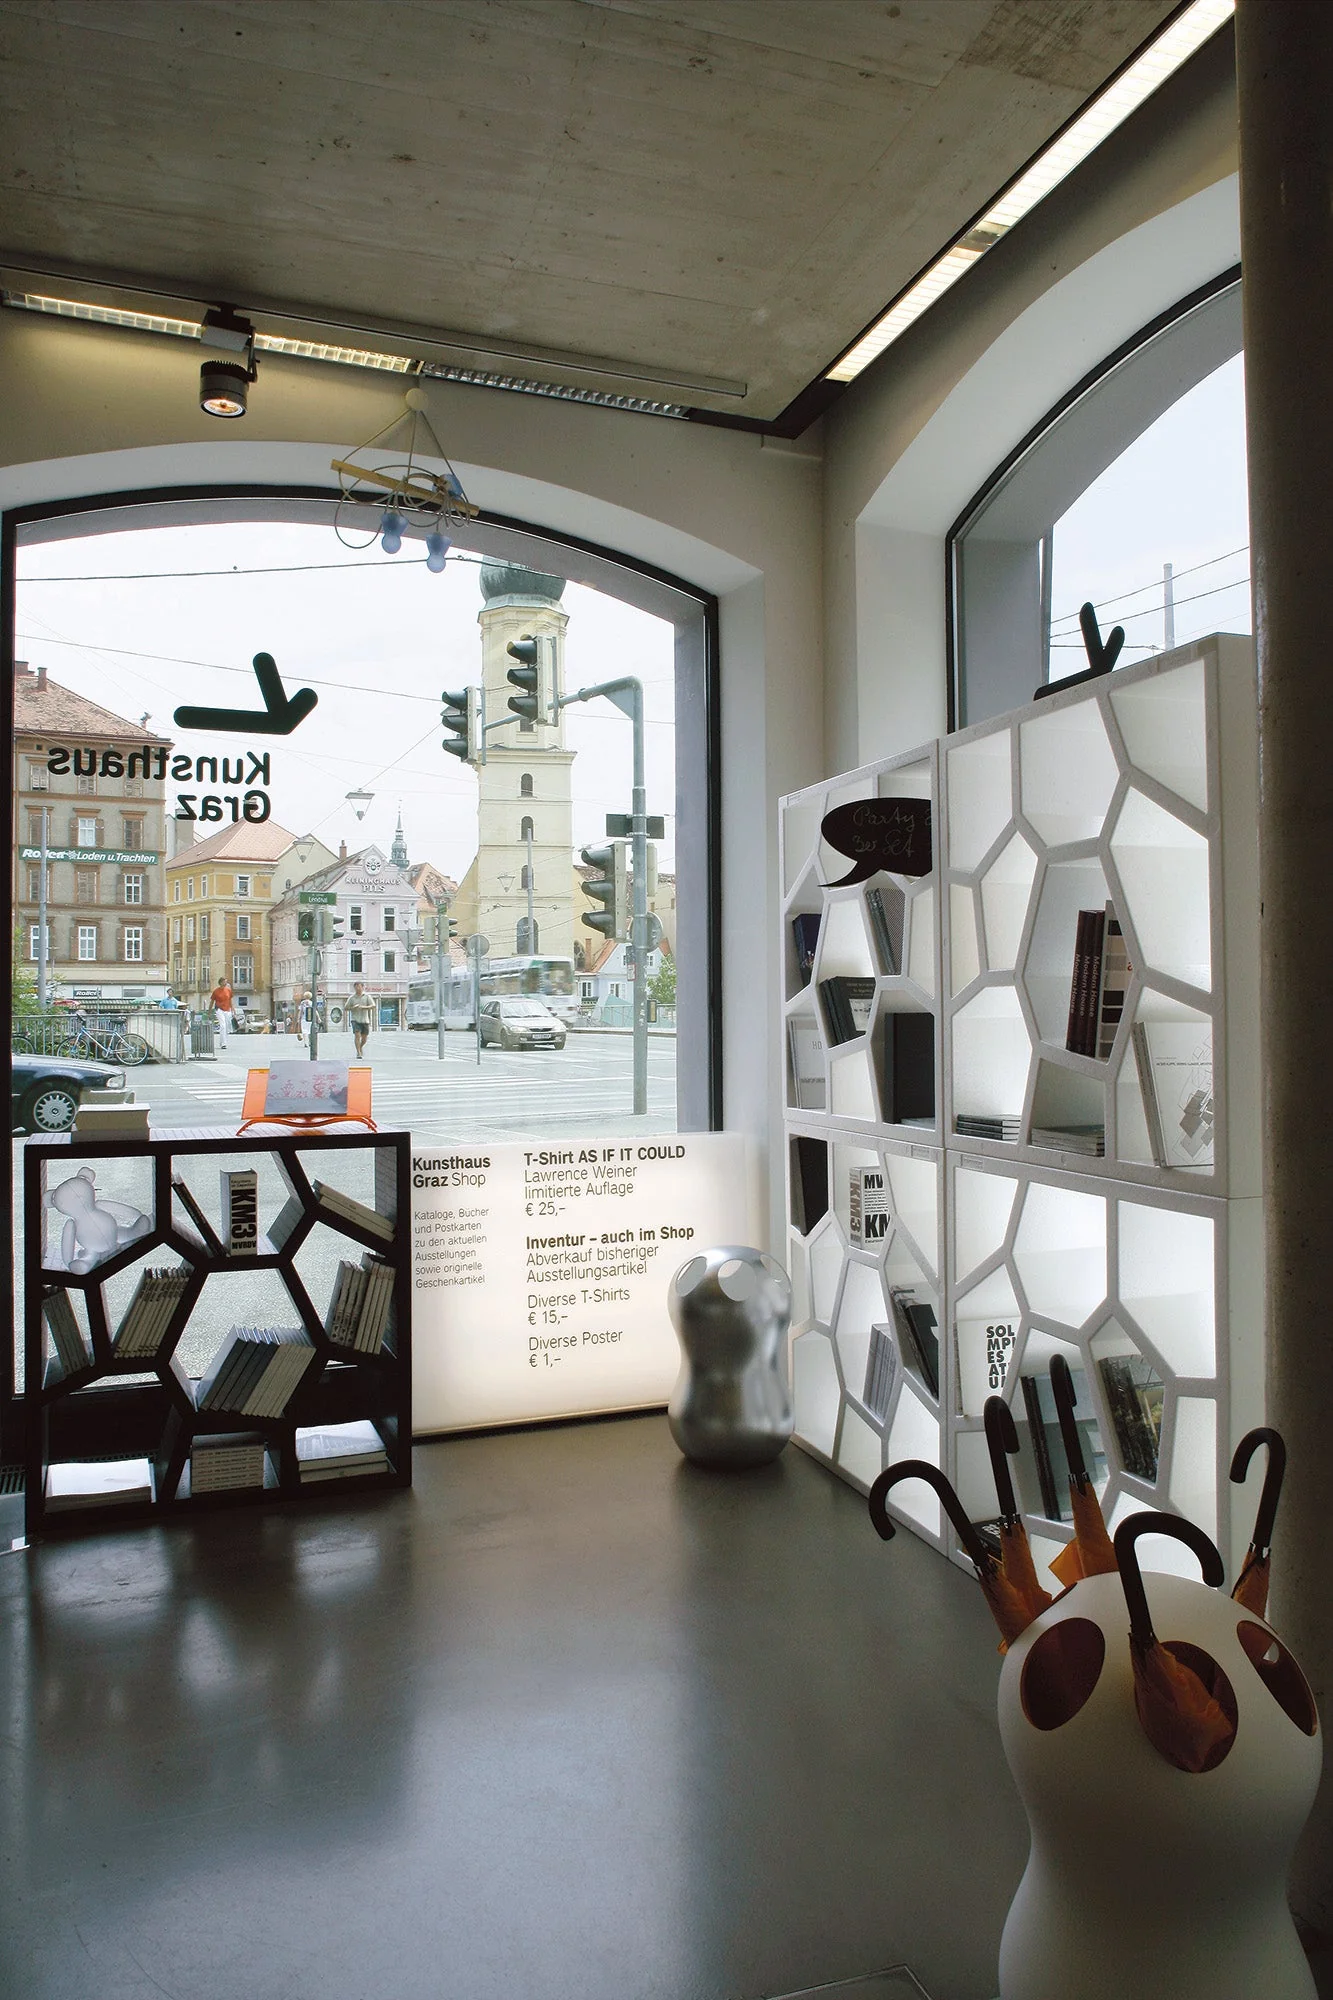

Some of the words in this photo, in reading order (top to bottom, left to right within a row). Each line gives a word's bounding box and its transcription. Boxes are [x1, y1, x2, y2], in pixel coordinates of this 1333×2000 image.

[77, 850, 106, 861] Loden
[362, 885, 386, 894] PILS
[1071, 953, 1081, 987] Modern
[1081, 955, 1090, 988] Modern
[1091, 955, 1100, 989] Modern
[1070, 987, 1078, 1014] House
[1079, 989, 1088, 1016] House
[1089, 990, 1097, 1017] House
[413, 1156, 491, 1171] Kunsthaus
[524, 1150, 574, 1166] T-Shirt
[578, 1149, 598, 1163] AS
[602, 1148, 615, 1162] IF
[620, 1148, 633, 1161] IT
[637, 1145, 685, 1160] COULD
[413, 1174, 449, 1188] Graz
[451, 1172, 486, 1188] Shop
[524, 1168, 588, 1183] Lawrence
[592, 1165, 638, 1180] Weiner
[524, 1185, 581, 1199] limitierte
[586, 1181, 634, 1197] Auflage
[231, 1188, 257, 1239] KM3
[414, 1210, 455, 1221] Kataloge,
[458, 1207, 490, 1218] Bücher
[525, 1202, 534, 1216] €
[849, 1182, 862, 1233] KM3
[415, 1223, 432, 1234] und
[435, 1221, 482, 1233] Postkarten
[415, 1239, 425, 1247] zu
[428, 1237, 445, 1246] den
[448, 1234, 487, 1245] aktuellen
[526, 1234, 586, 1250] Inventur
[601, 1229, 634, 1244] auch
[639, 1228, 656, 1241] im
[660, 1226, 695, 1241] Shop
[415, 1249, 477, 1261] Ausstellungen
[526, 1248, 593, 1267] Abverkauf
[597, 1244, 659, 1261] bisheriger
[415, 1264, 441, 1275] sowie
[444, 1261, 483, 1273] originelle
[526, 1261, 648, 1283] Ausstellungsartikel
[415, 1275, 486, 1289] Geschenkartikel
[528, 1293, 577, 1309] Diverse
[581, 1287, 631, 1304] T-Shirts
[527, 1311, 537, 1326] €
[528, 1335, 578, 1351] Diverse
[582, 1329, 623, 1346] Poster
[986, 1324, 1015, 1339] SOL
[528, 1354, 538, 1368] €
[987, 1350, 1005, 1363] ES
[989, 1362, 1010, 1377] AT
